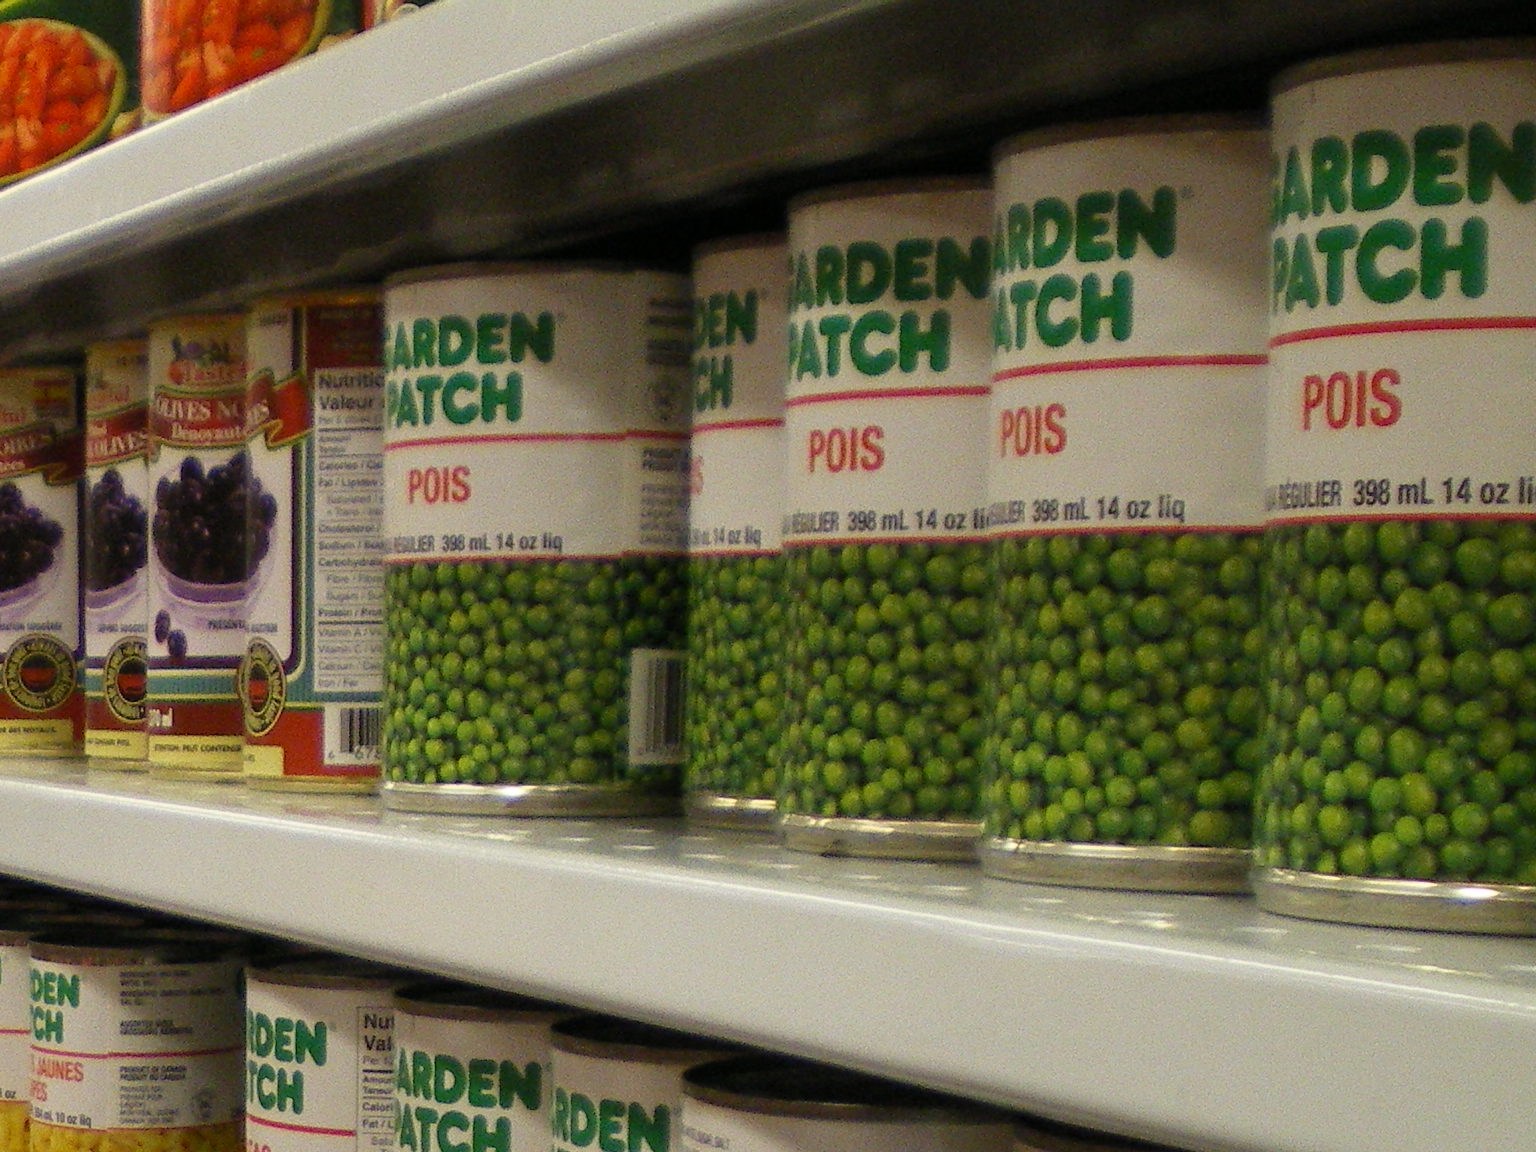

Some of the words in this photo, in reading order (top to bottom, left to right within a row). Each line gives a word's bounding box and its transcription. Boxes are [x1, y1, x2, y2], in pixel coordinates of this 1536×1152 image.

[1300, 368, 1403, 430] POIS
[808, 425, 885, 473] POIS
[999, 402, 1067, 457] POIS
[408, 466, 472, 505] POIS
[1353, 478, 1391, 507] 398
[1398, 477, 1434, 505] mL
[1442, 475, 1472, 504] 14
[1480, 481, 1510, 503] oz
[848, 510, 878, 532] 398
[882, 510, 908, 531] mL
[915, 509, 938, 530] 14
[944, 513, 967, 530] oz
[1032, 499, 1059, 523] 398
[1064, 497, 1090, 522] mL
[1097, 496, 1120, 520] 14
[1127, 501, 1151, 519] oz
[1158, 493, 1186, 524] liq
[496, 532, 517, 551] 14
[519, 536, 538, 551] oz
[30, 1004, 64, 1044] CH
